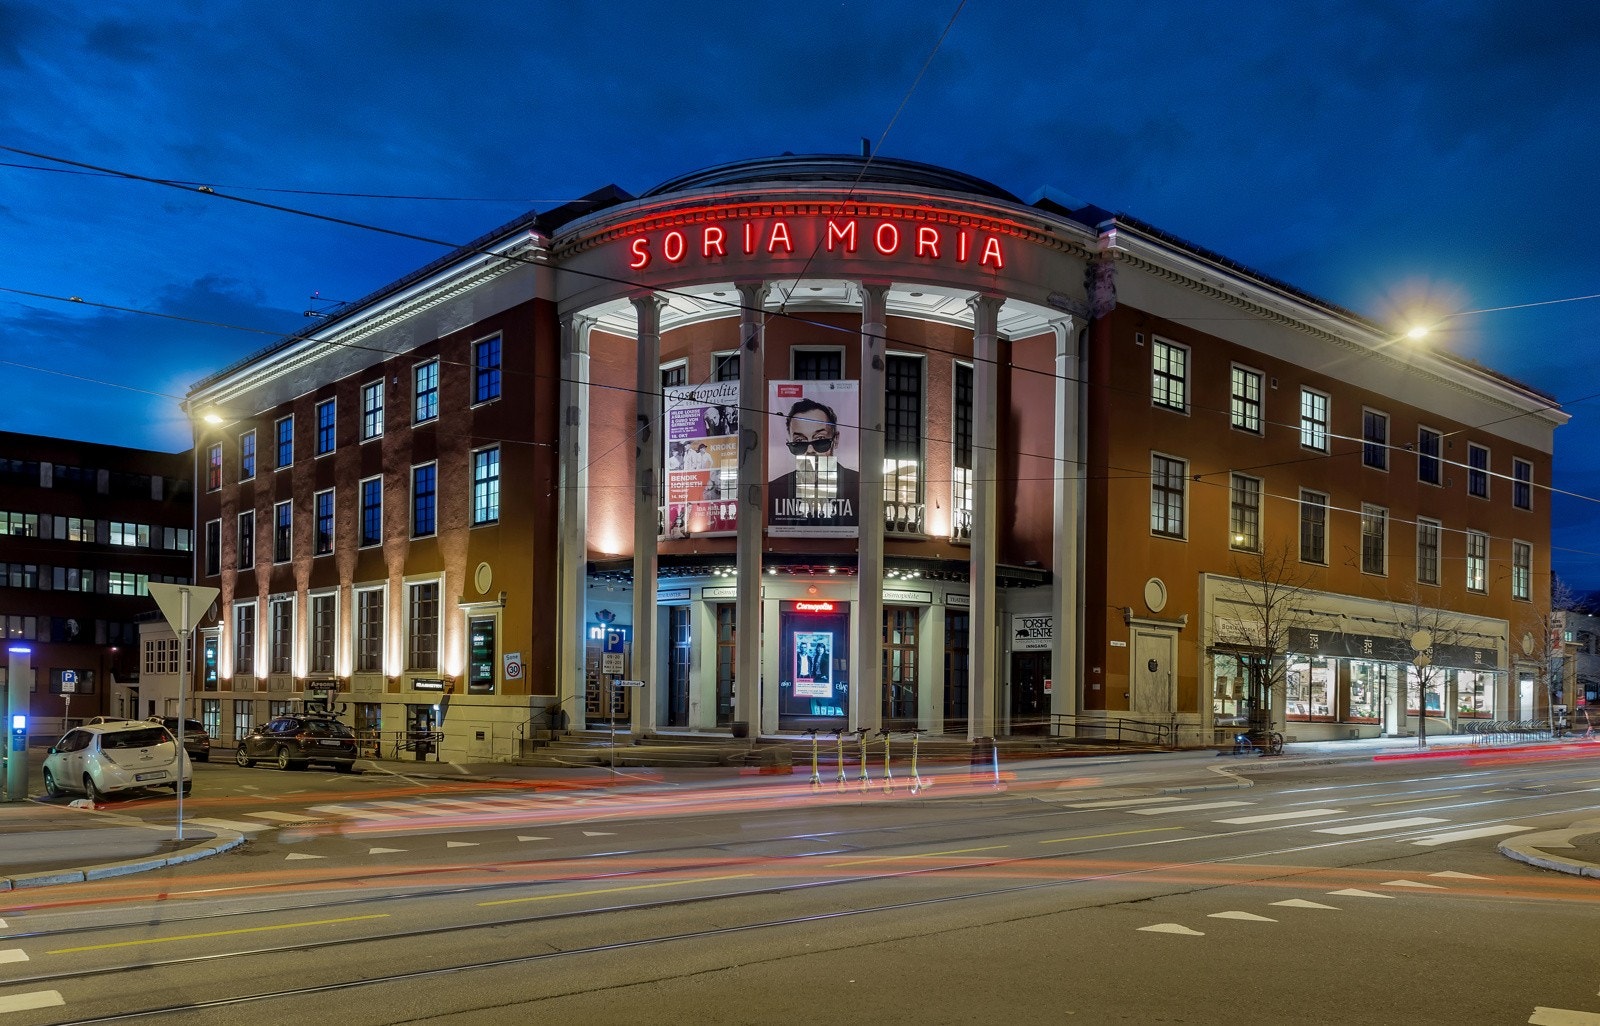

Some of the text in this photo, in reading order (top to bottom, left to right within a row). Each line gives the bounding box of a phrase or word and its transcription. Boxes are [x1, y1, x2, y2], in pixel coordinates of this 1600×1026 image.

[630, 220, 1005, 269] SORIA MORIA
[710, 442, 737, 451] KROKE
[796, 602, 833, 612] Cosmopolite
[608, 633, 620, 651] P
[509, 665, 518, 675] 30
[65, 673, 72, 681] P
